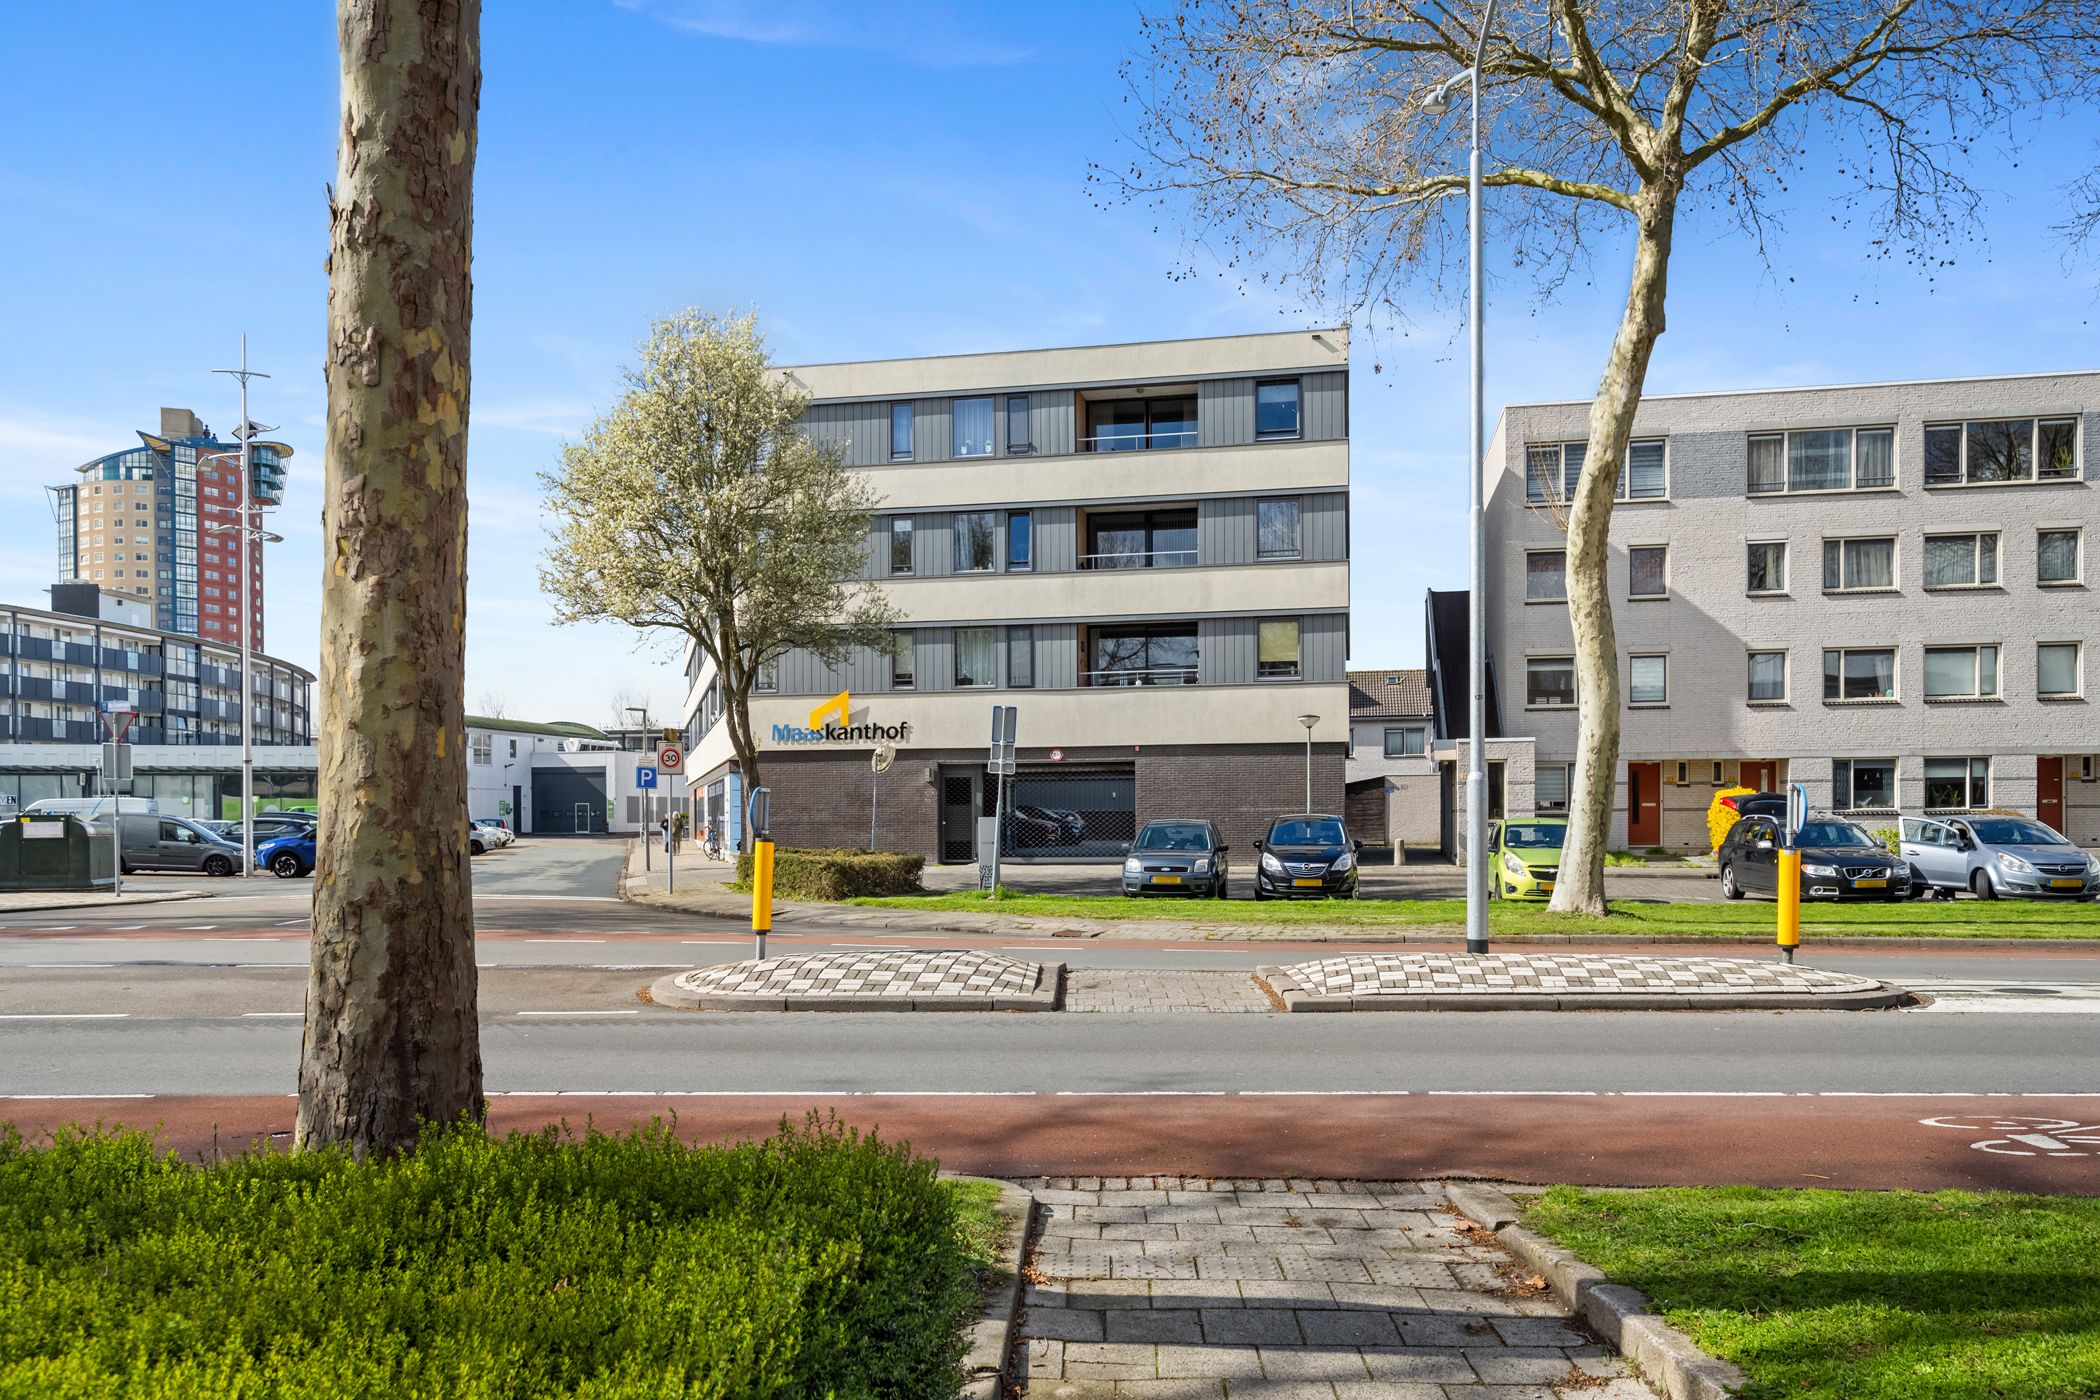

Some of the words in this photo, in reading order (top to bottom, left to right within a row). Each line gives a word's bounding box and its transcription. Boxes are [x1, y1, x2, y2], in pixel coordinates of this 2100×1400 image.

[771, 721, 908, 742] Maaskanthof
[665, 754, 677, 762] 30
[641, 769, 653, 786] P
